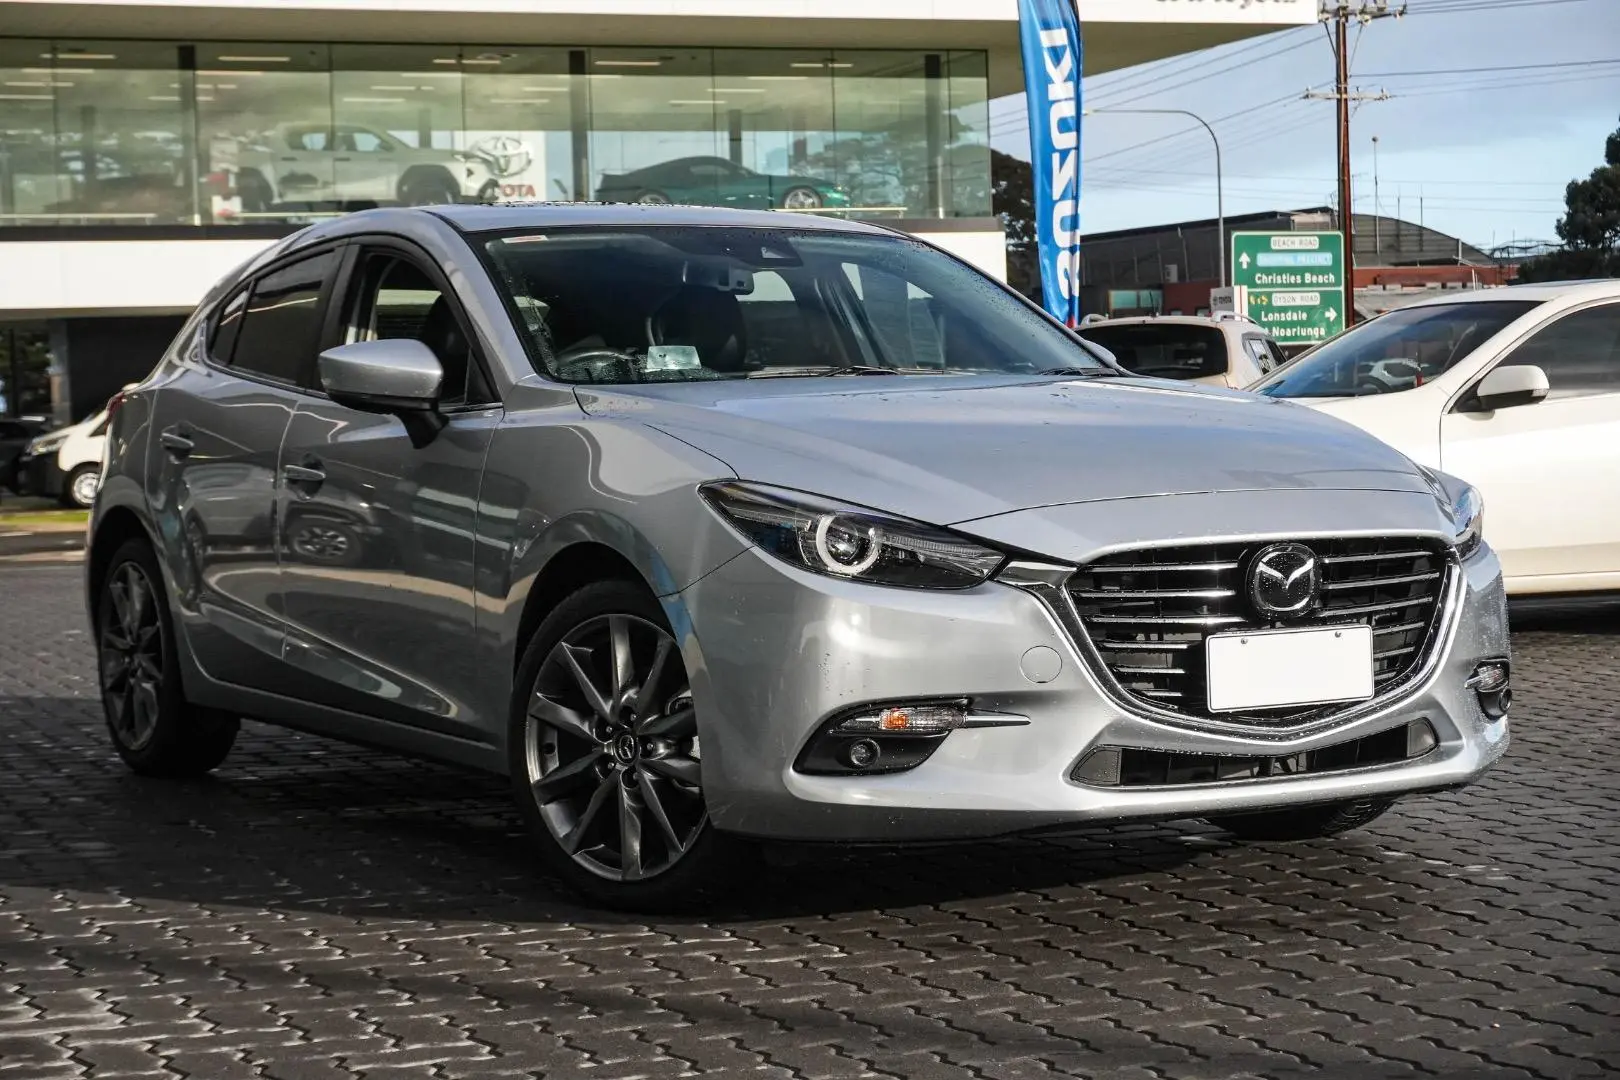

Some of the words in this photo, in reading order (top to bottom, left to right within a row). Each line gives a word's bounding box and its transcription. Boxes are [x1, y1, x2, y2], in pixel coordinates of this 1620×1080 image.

[1040, 28, 1080, 299] SUZUKI
[1255, 273, 1302, 284] Christies
[1305, 272, 1335, 283] Beach
[1300, 294, 1318, 303] ROAD
[1262, 311, 1308, 321] Lonsdale
[1272, 326, 1326, 338] Noarlunga
